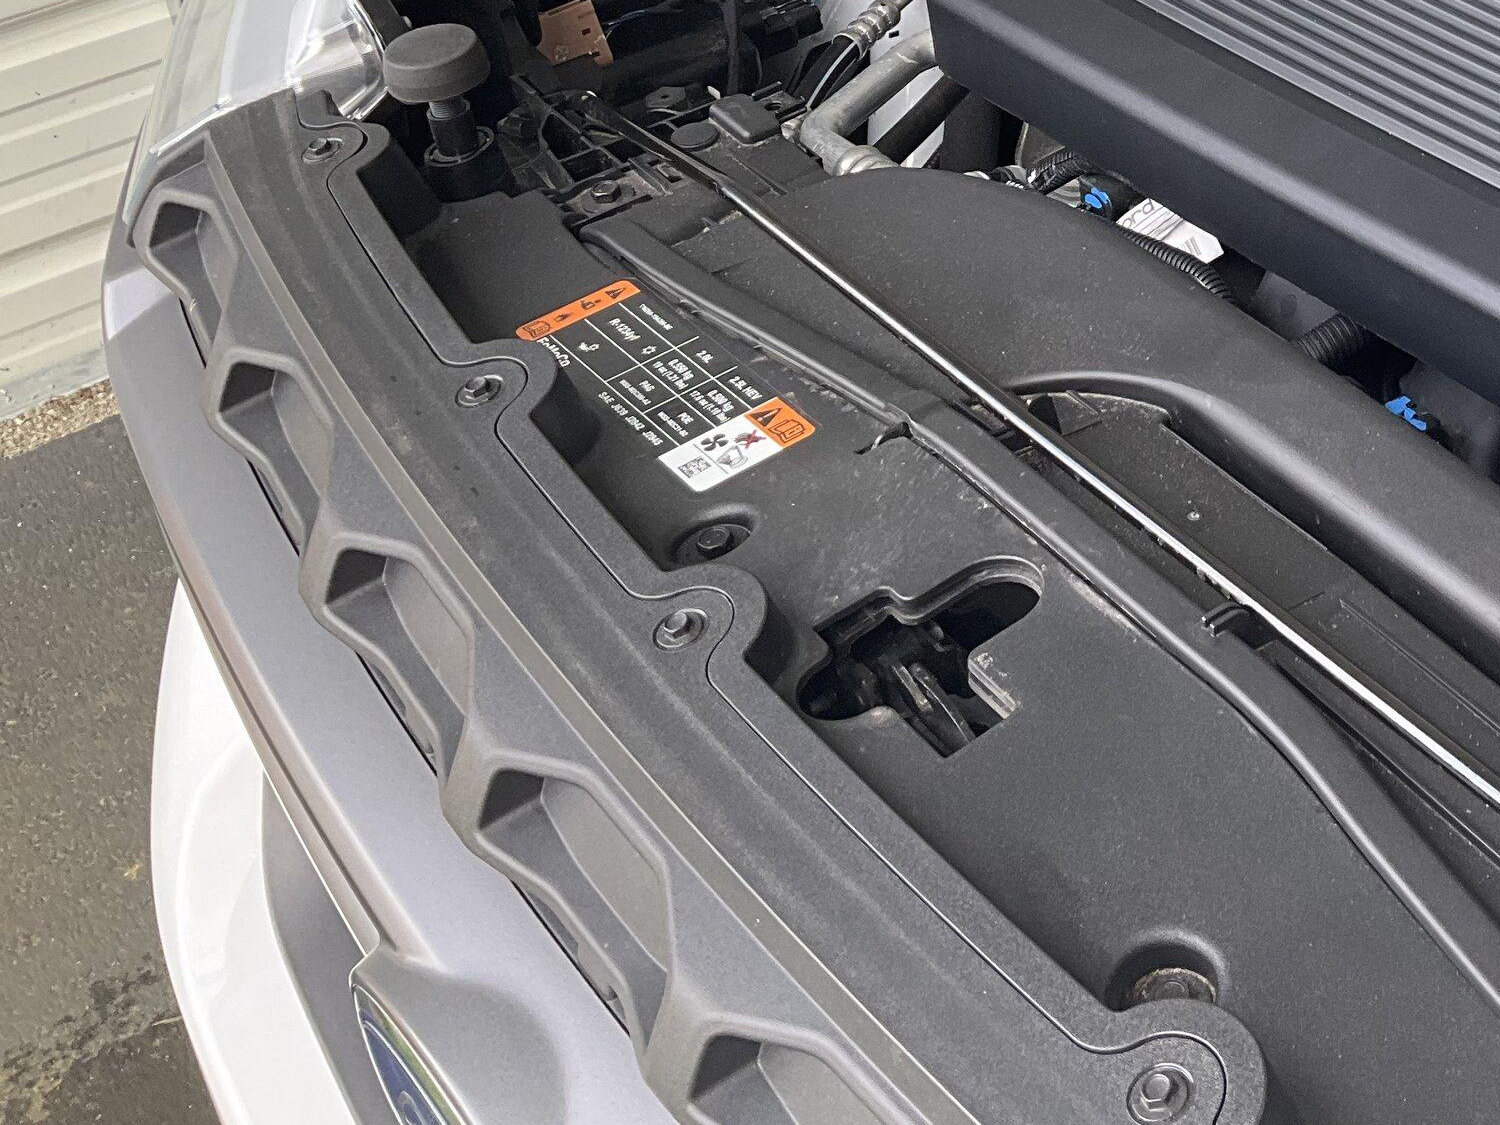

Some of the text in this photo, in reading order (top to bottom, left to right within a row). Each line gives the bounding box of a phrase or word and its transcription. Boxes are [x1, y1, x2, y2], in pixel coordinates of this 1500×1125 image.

[1121, 197, 1155, 227] ord
[609, 318, 642, 342] R-1234yf
[682, 370, 694, 381] kg
[598, 391, 616, 404] SAE
[742, 386, 763, 400] HEV
[677, 412, 694, 425] POE
